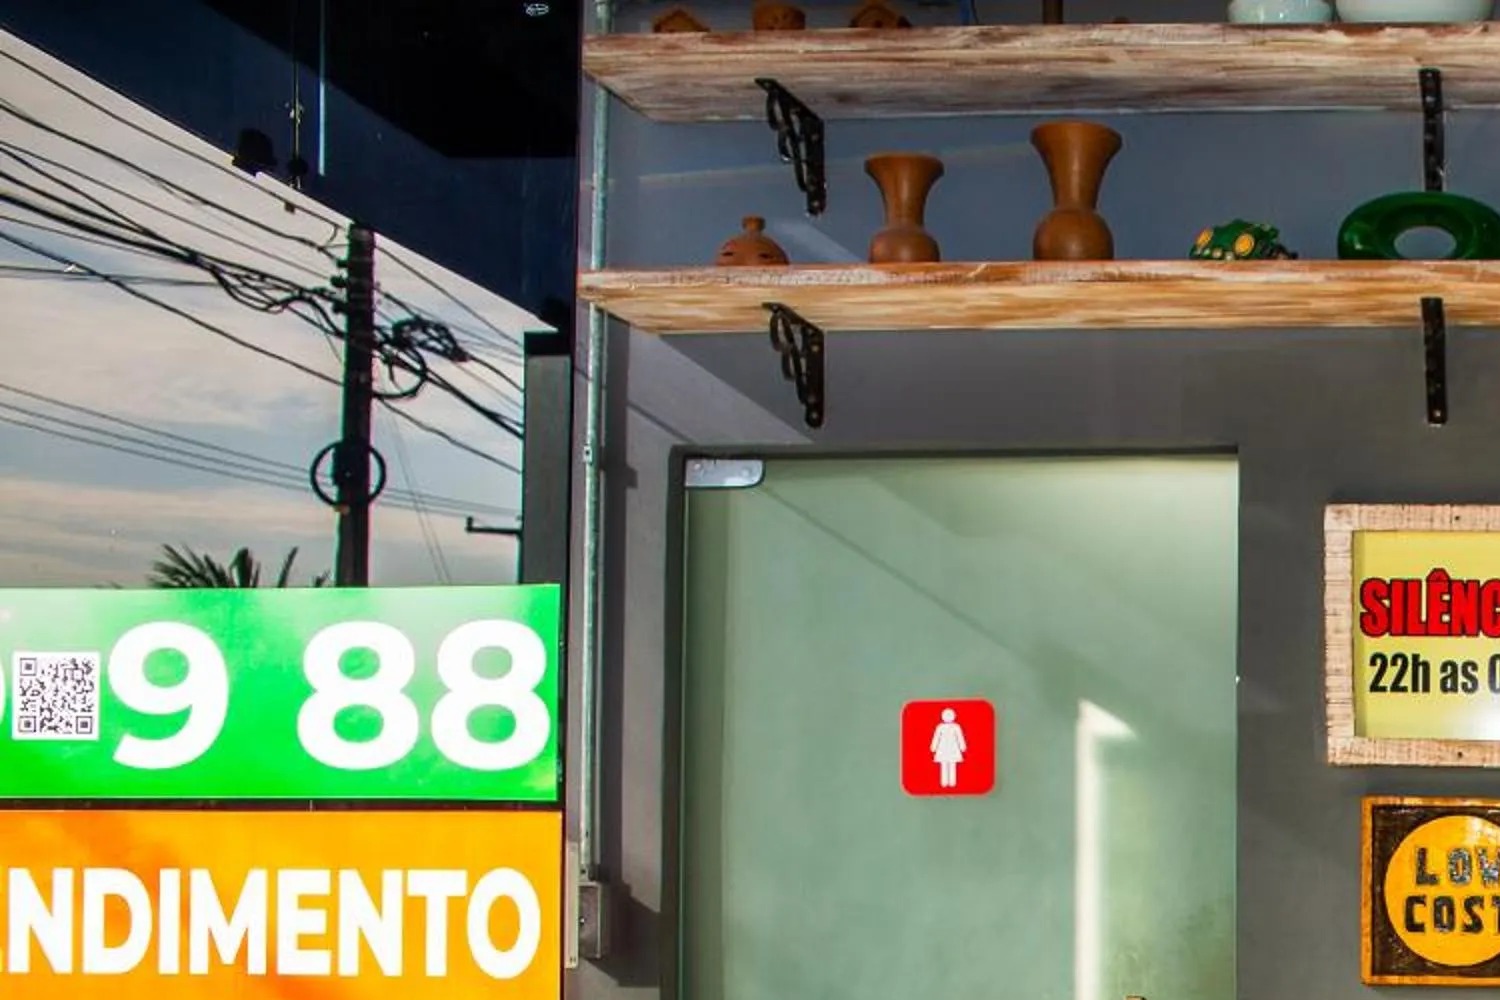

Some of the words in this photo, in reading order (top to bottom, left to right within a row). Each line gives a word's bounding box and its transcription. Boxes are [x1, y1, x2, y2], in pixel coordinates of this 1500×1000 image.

[297, 620, 550, 770] 88
[1368, 652, 1430, 693] 22h
[1439, 659, 1478, 694] as
[0, 867, 541, 979] NDIMENTO
